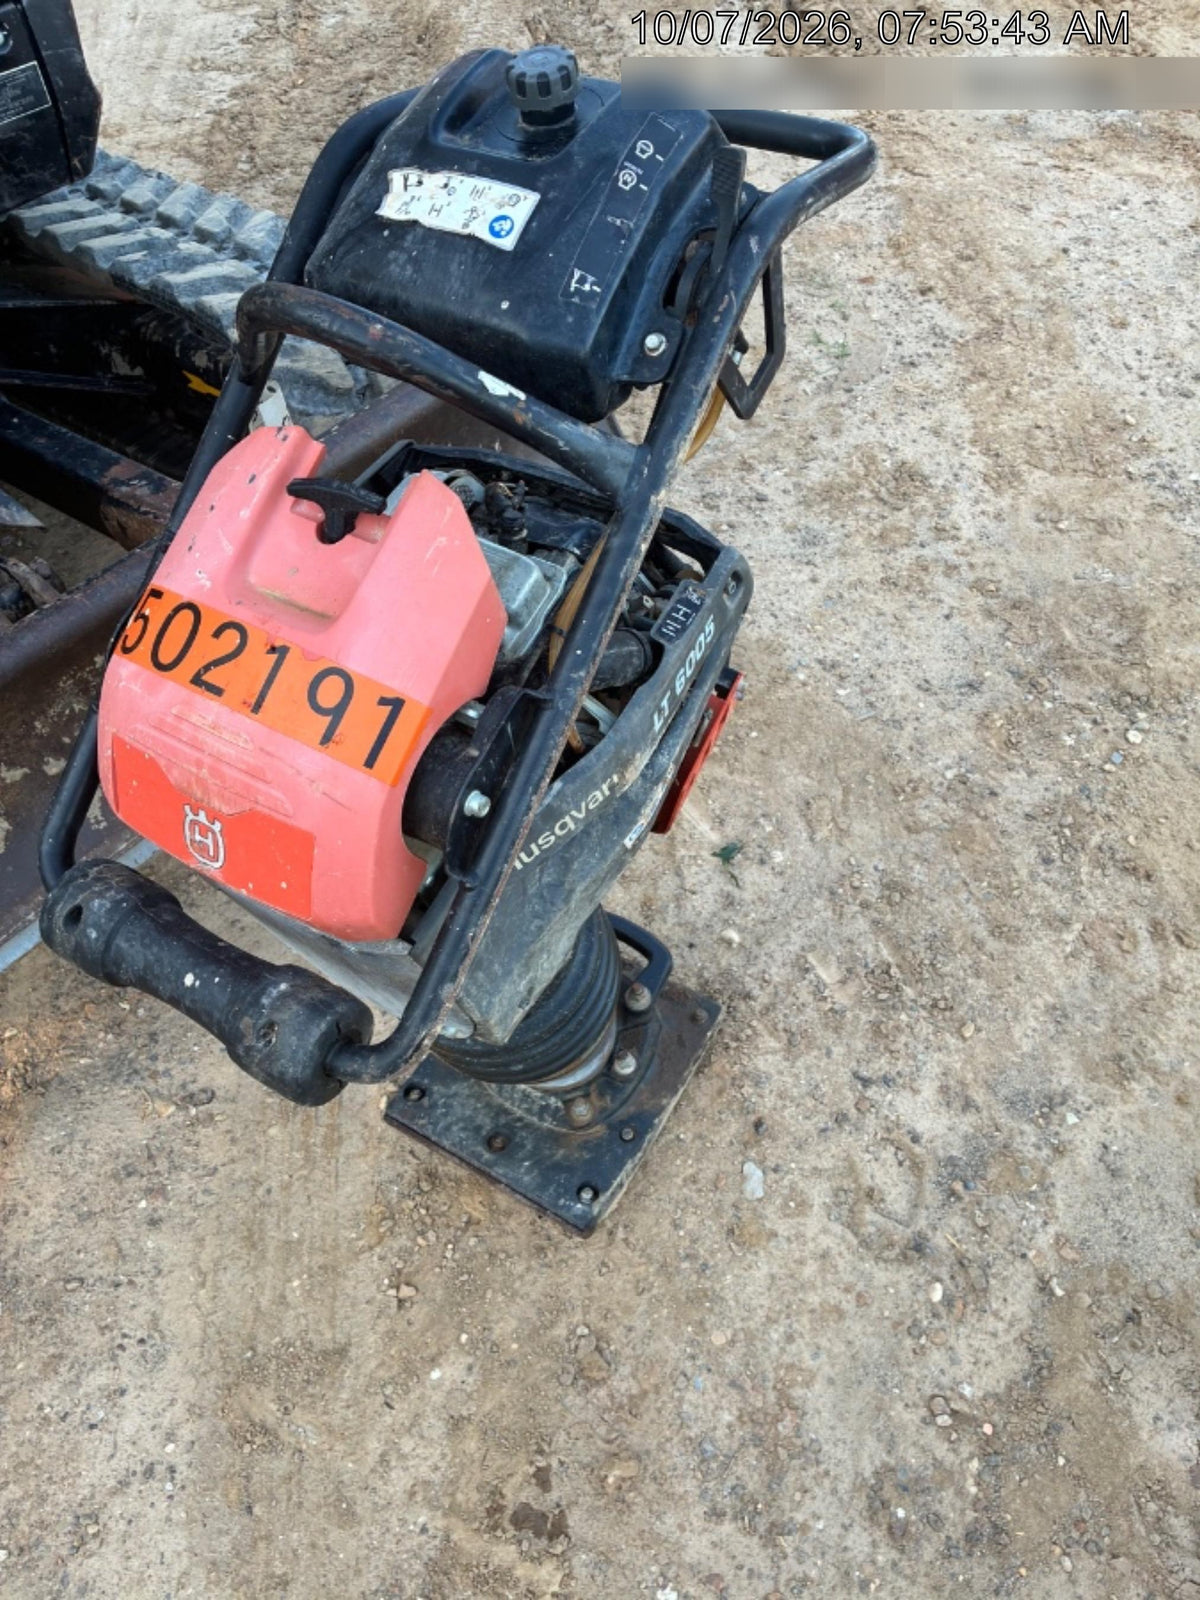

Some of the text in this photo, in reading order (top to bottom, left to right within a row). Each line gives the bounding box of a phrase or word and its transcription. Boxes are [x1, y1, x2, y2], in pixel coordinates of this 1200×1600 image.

[119, 587, 406, 771] 502191
[652, 613, 717, 733] LT 6005
[513, 773, 620, 871] usqvar
